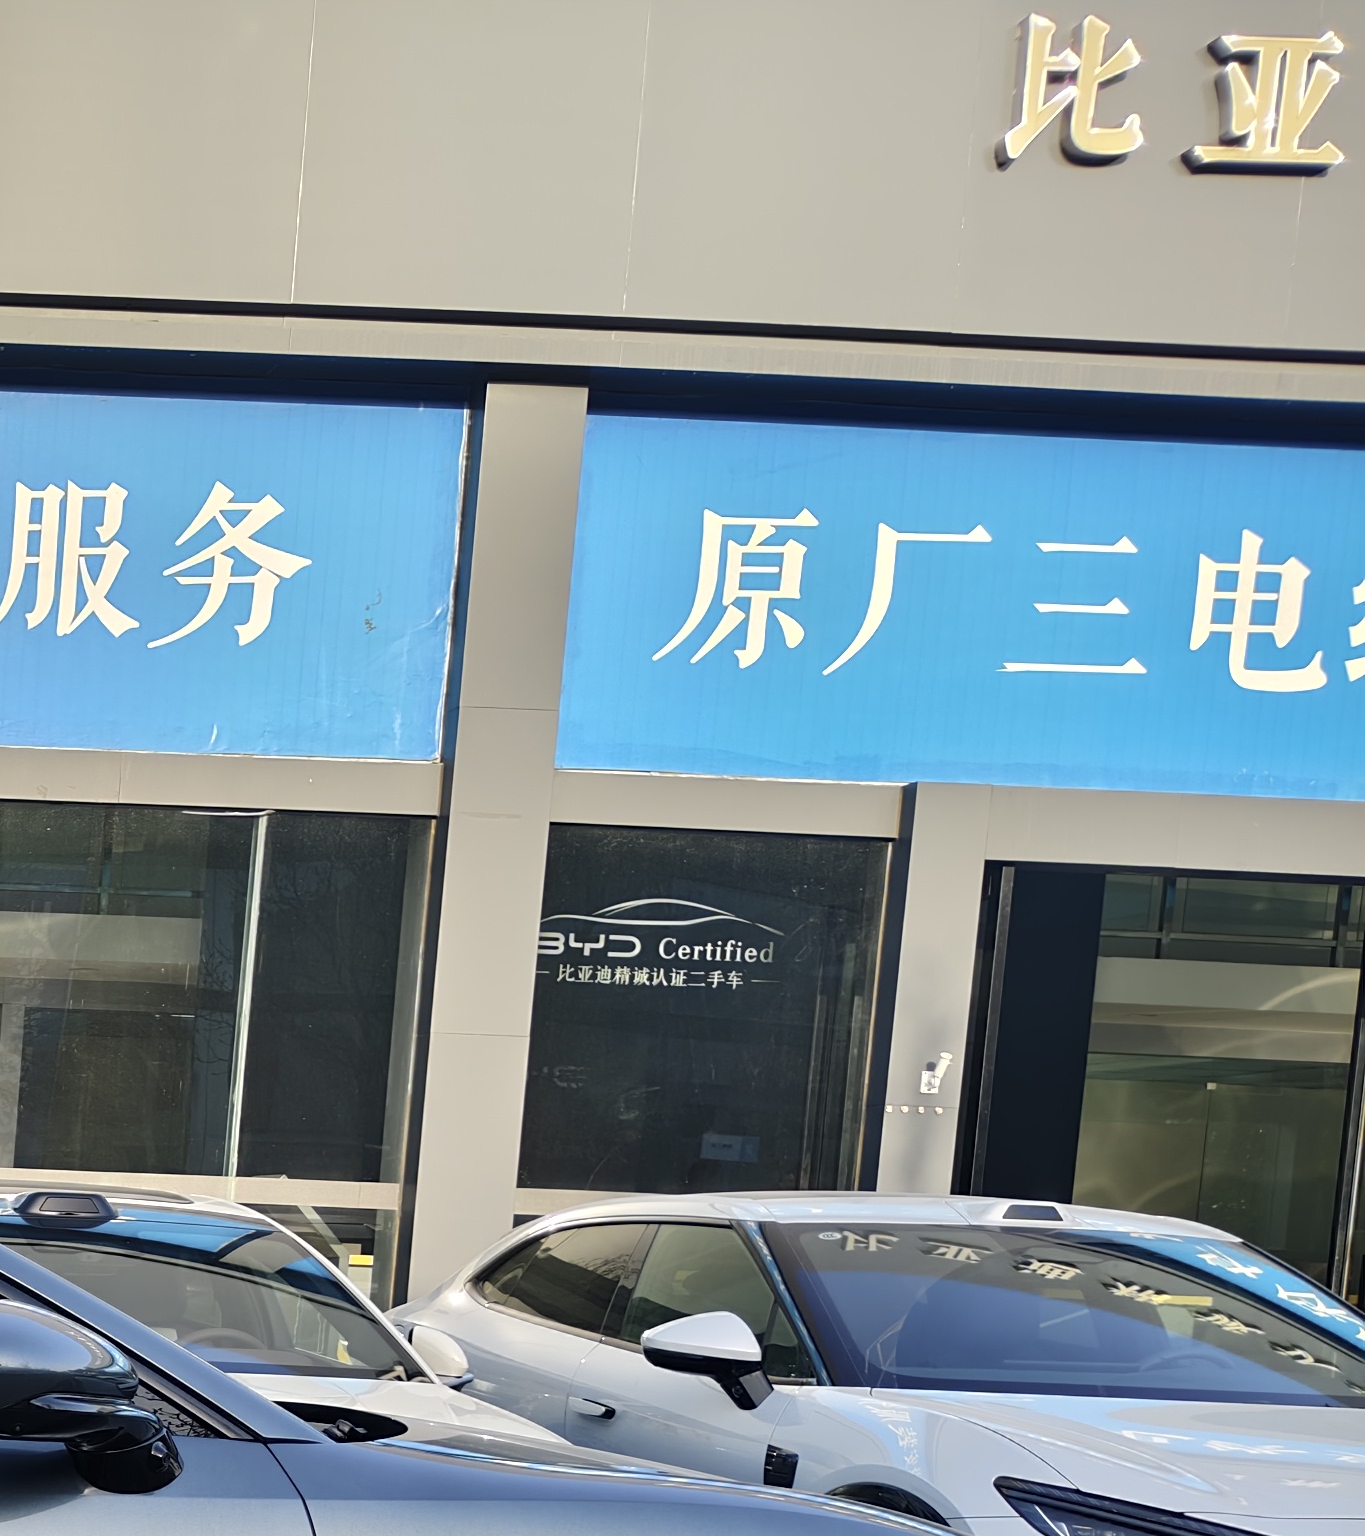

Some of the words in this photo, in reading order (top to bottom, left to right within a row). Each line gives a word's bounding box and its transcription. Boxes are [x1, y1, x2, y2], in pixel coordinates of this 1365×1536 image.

[993, 12, 1346, 177] 比亚
[651, 507, 1365, 693] 原厂三电
[537, 931, 642, 959] BYD
[658, 937, 774, 963] Certified
[556, 963, 744, 990] 比亚迪精诚认证二手车
